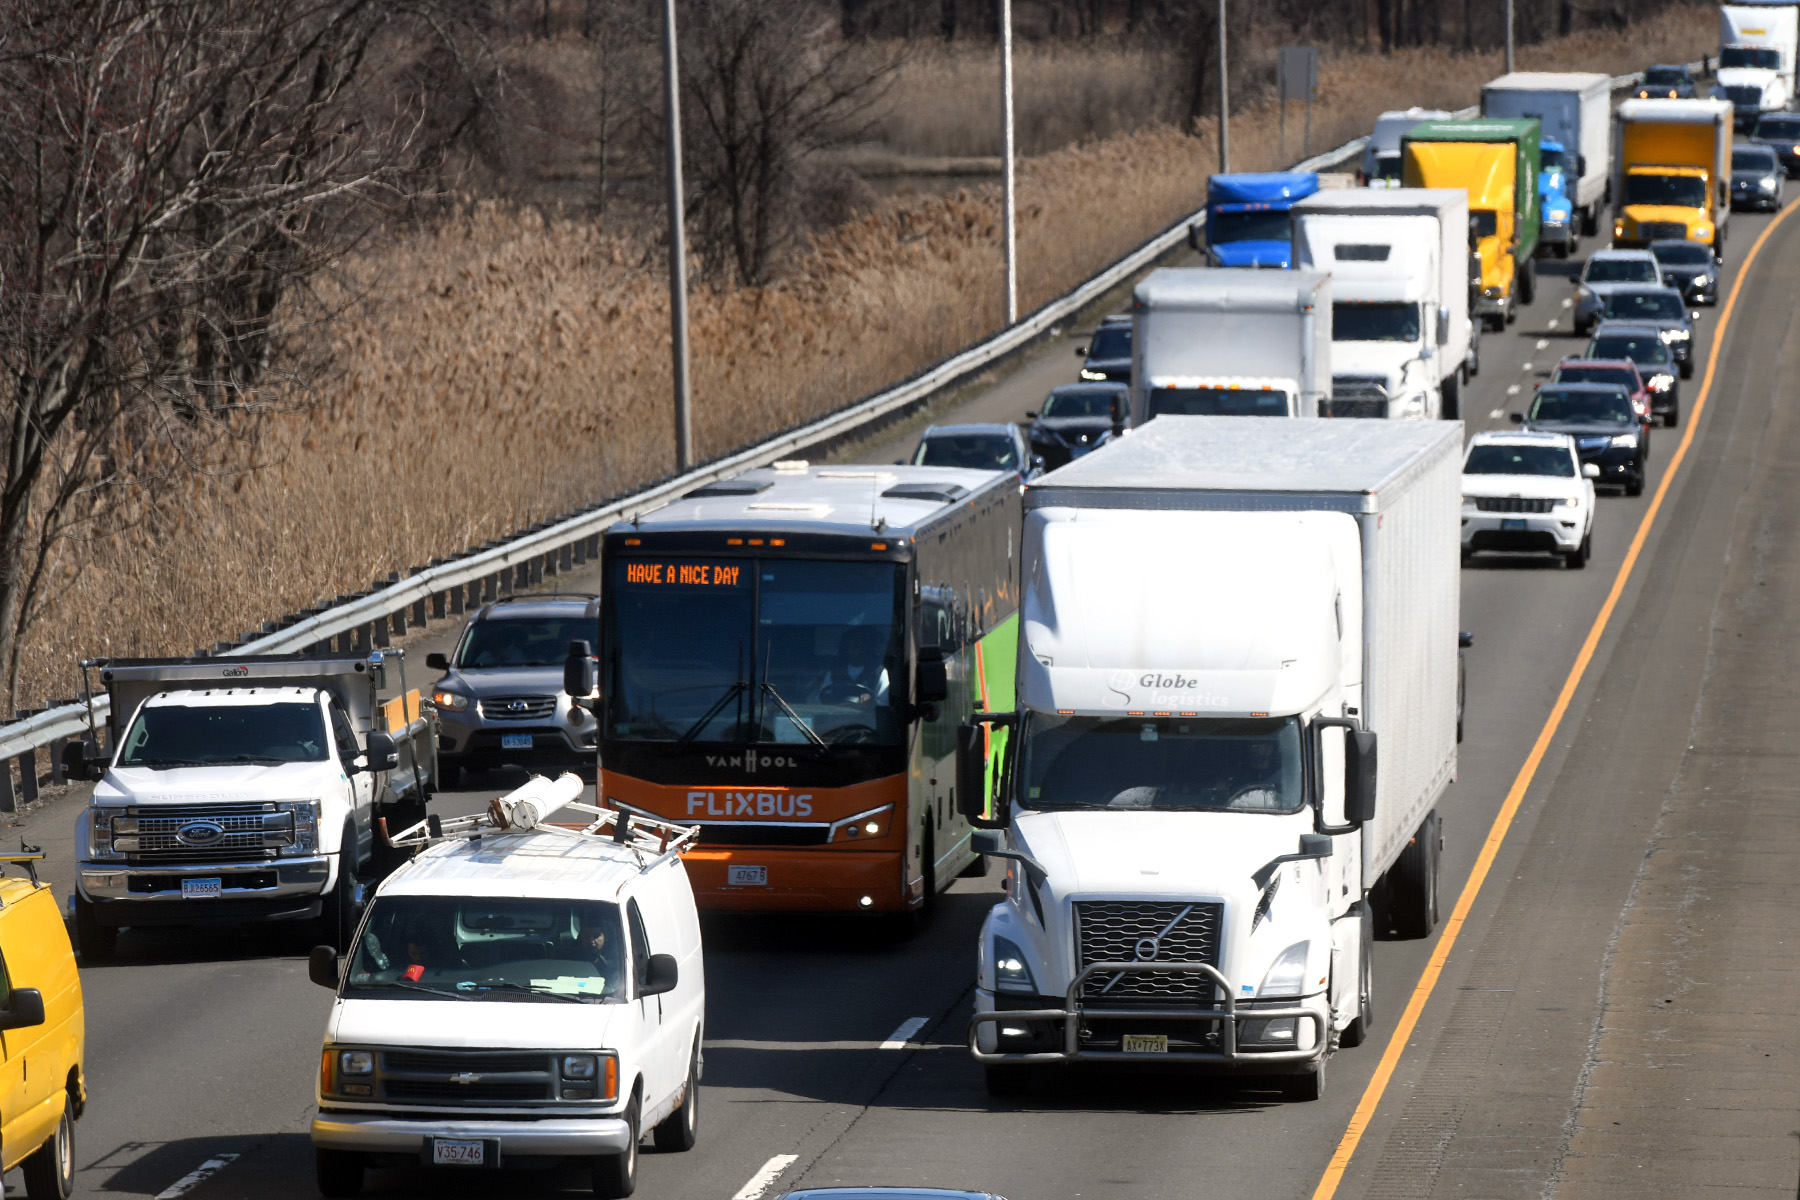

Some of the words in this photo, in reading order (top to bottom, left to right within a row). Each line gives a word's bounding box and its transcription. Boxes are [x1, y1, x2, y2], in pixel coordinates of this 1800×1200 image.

[627, 564, 663, 584] HAVE
[666, 564, 676, 584] A
[679, 564, 710, 585] NICE
[713, 565, 739, 586] DAY
[1139, 673, 1198, 689] Globe
[1150, 690, 1230, 711] logistics
[705, 755, 742, 767] VAN
[189, 828, 212, 838] Ford
